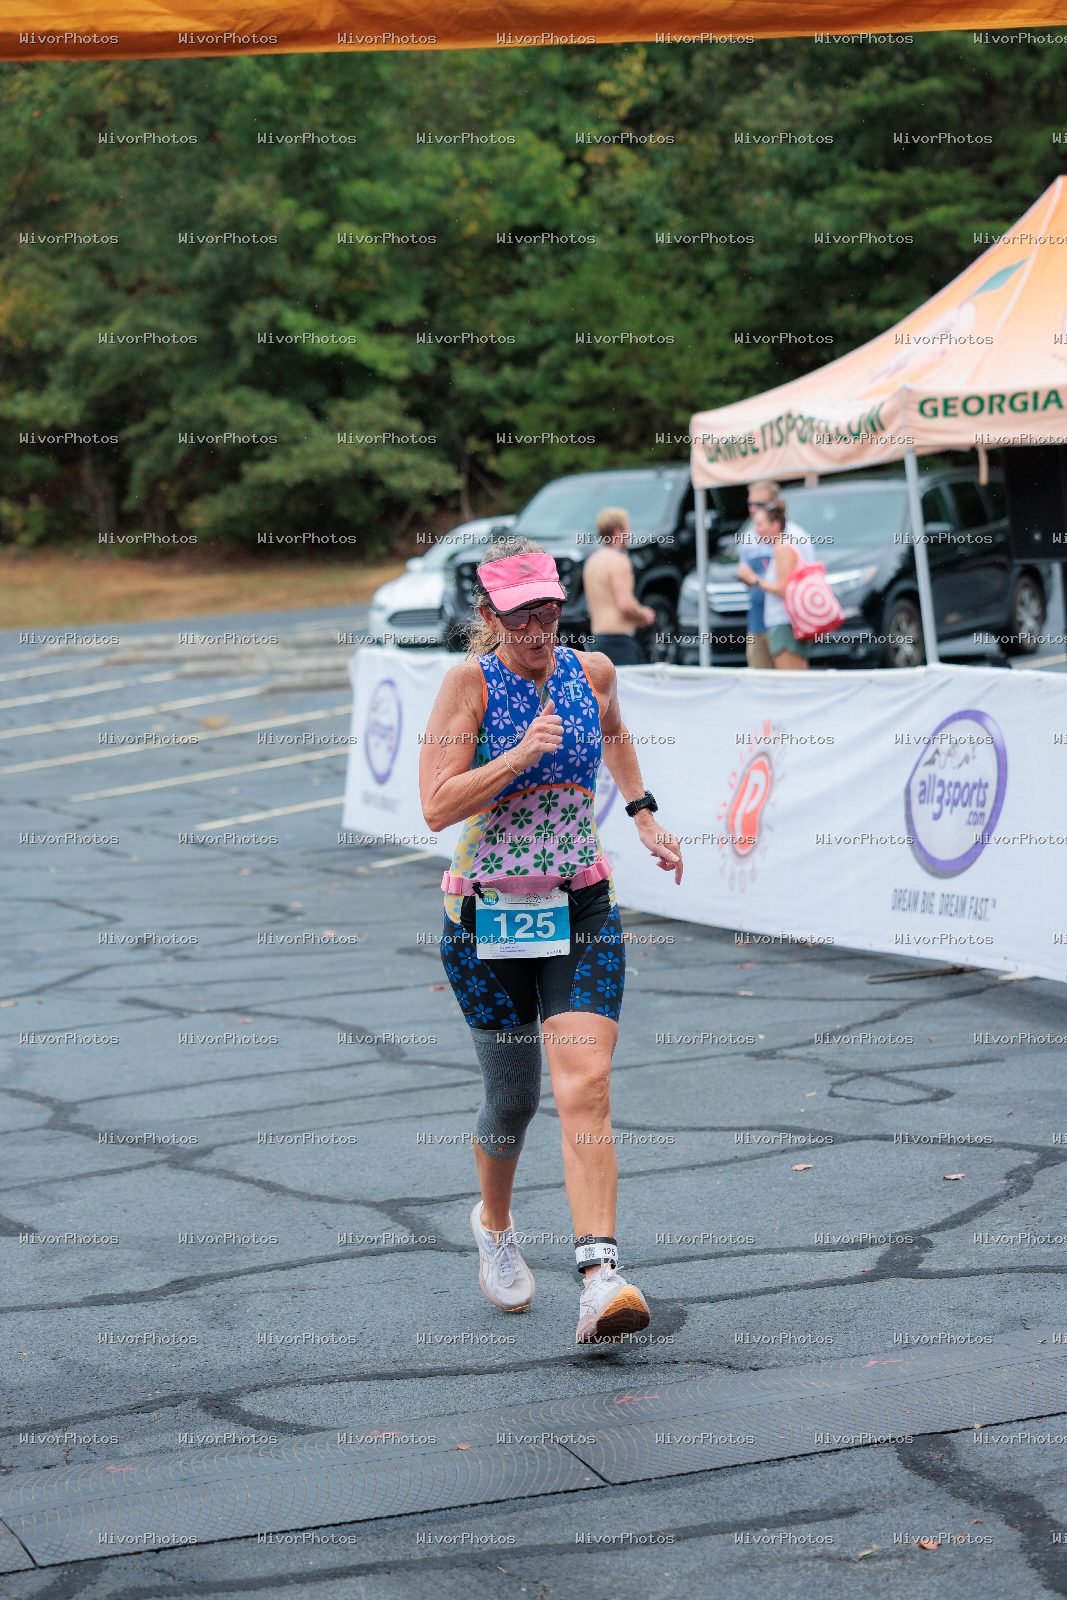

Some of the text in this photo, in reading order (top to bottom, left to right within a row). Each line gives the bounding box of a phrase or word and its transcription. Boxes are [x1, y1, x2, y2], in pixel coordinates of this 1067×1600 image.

[919, 389, 1065, 419] GEORGIA
[917, 773, 990, 821] all3sports
[891, 888, 919, 913] DREAM
[939, 892, 967, 919] DREAM
[494, 911, 556, 939] 125
[603, 1247, 616, 1257] 125
